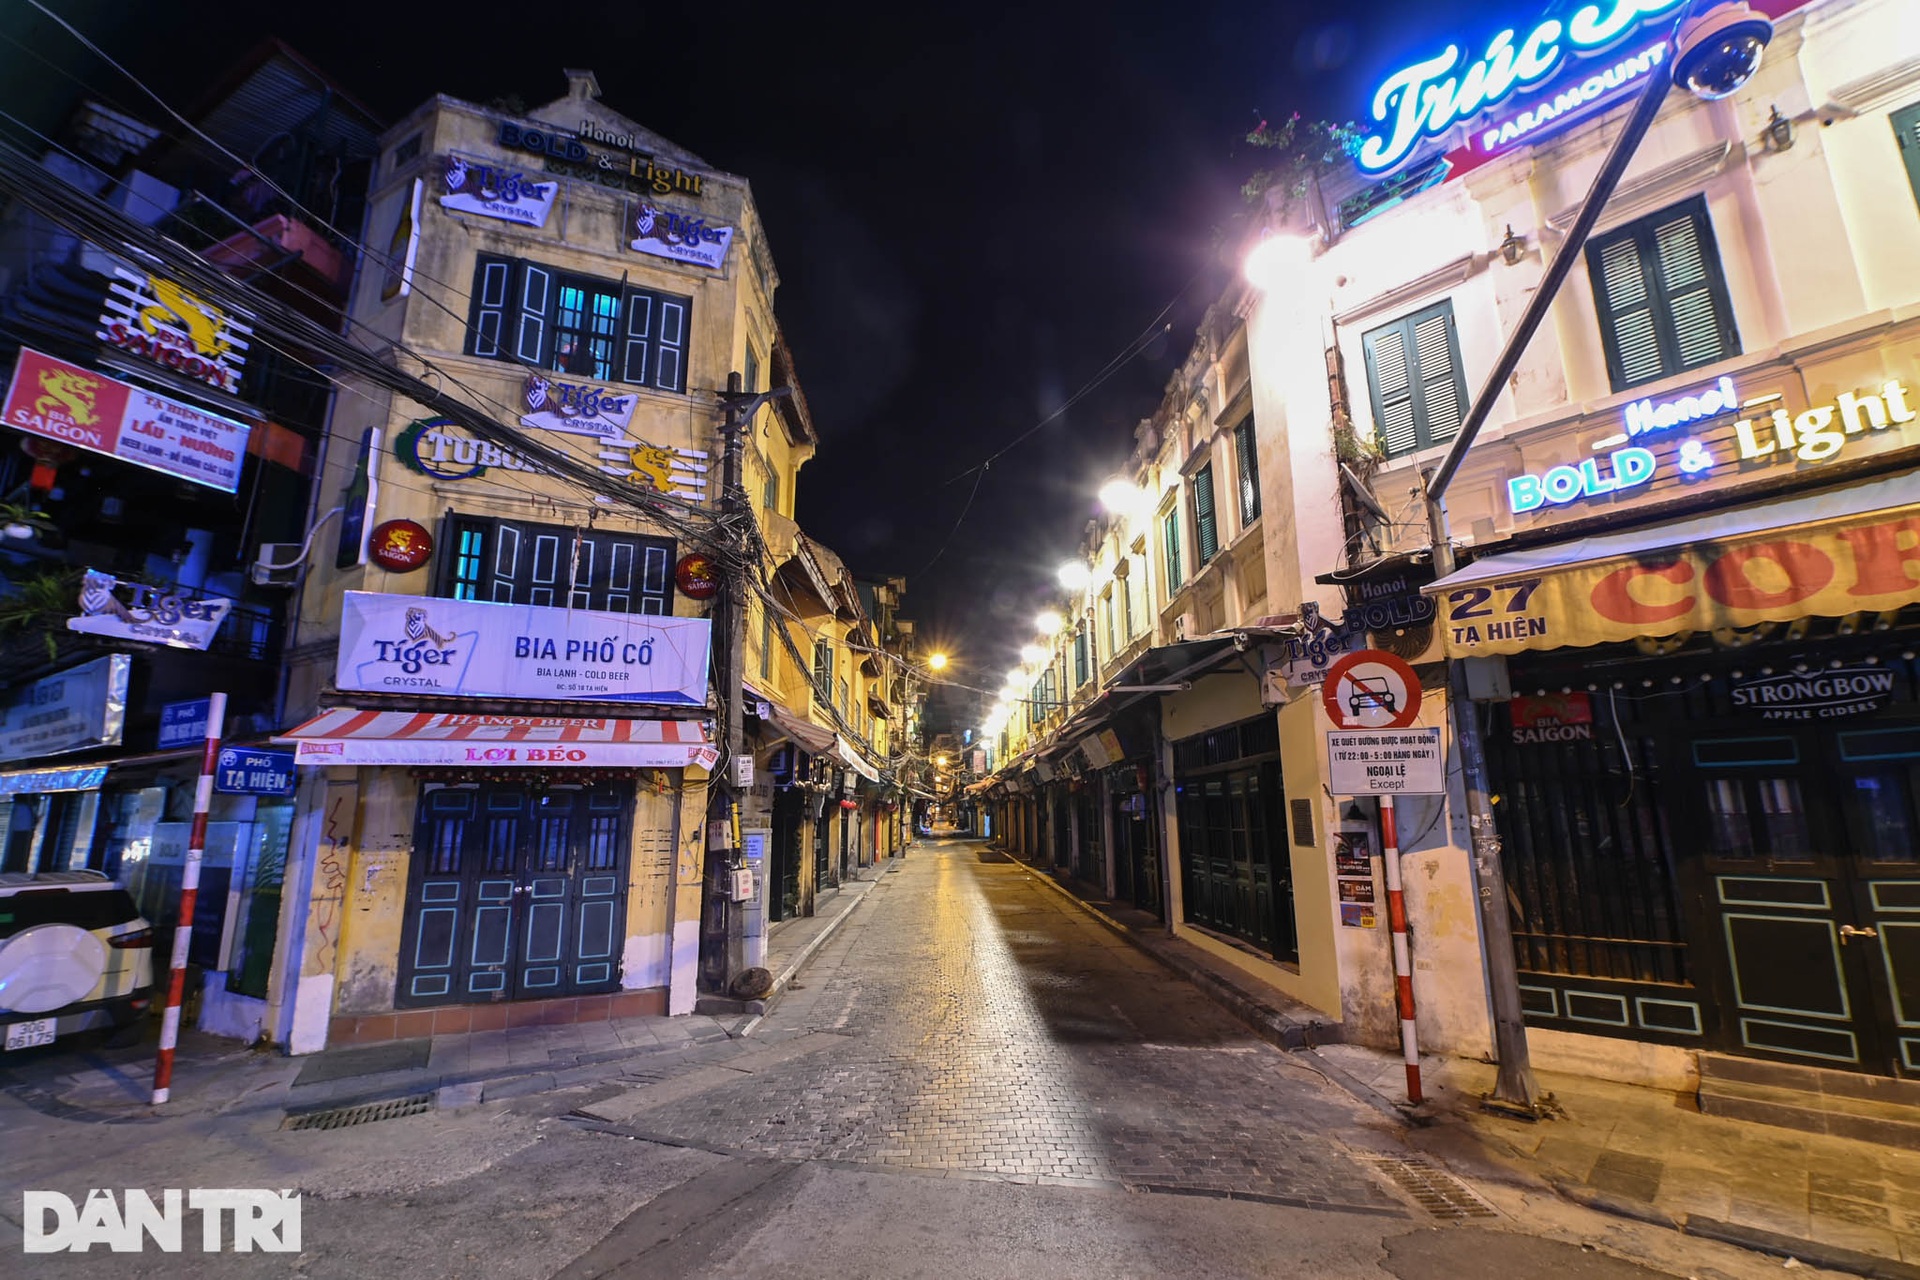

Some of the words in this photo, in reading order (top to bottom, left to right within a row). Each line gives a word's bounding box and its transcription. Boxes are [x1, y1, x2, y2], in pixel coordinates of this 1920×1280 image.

[1483, 42, 1668, 151] PARAMOUNT
[580, 119, 635, 150] Hanoi
[499, 120, 588, 162] BOLD
[599, 153, 613, 170] &
[630, 156, 702, 194] Light
[474, 164, 550, 202] Tiger
[482, 201, 536, 220] CRYSTAL
[664, 211, 727, 247] Tiger
[668, 245, 715, 263] CRYSTAL
[108, 324, 227, 388] SAIGON
[558, 382, 629, 418] Tiger
[1625, 375, 1737, 437] Hanoi
[14, 409, 102, 446] SAIGON
[49, 410, 75, 425] BIA
[563, 417, 616, 435] CRYSTAL
[1508, 447, 1657, 513] BOLD
[1679, 440, 1714, 474] &
[1734, 379, 1917, 461] Light
[1361, 577, 1407, 599] Hanoi
[1449, 578, 1543, 621] 27
[127, 581, 222, 625] Tiger
[1347, 595, 1434, 634] BOLD
[1452, 626, 1482, 646] TẠ
[1487, 616, 1547, 643] HIỆN
[374, 639, 457, 674] Tiger
[515, 636, 557, 660] BIA
[565, 636, 619, 663] PHỐ
[622, 637, 655, 665] CỔ
[383, 676, 441, 687] CRYSTAL
[537, 667, 552, 677] BIA
[554, 668, 577, 679] LẠNH
[584, 670, 607, 680] COLD
[608, 672, 630, 681] BEER
[1732, 673, 1894, 705] STRONGBOW
[449, 714, 532, 727] HANOI
[541, 717, 599, 728] BEER
[1536, 717, 1560, 727] BIA
[1763, 710, 1811, 719] APPLE
[1818, 701, 1877, 717] CIDERS
[1332, 738, 1340, 747] XE
[1512, 724, 1590, 743] SAIGON
[245, 755, 272, 768] PHỐ
[526, 745, 587, 762] BÉO
[226, 770, 245, 790] TẠ
[249, 769, 287, 791] HIỆN
[1367, 766, 1393, 778] NGOẠI
[1396, 763, 1406, 777] LỆ
[1370, 779, 1404, 790] Except
